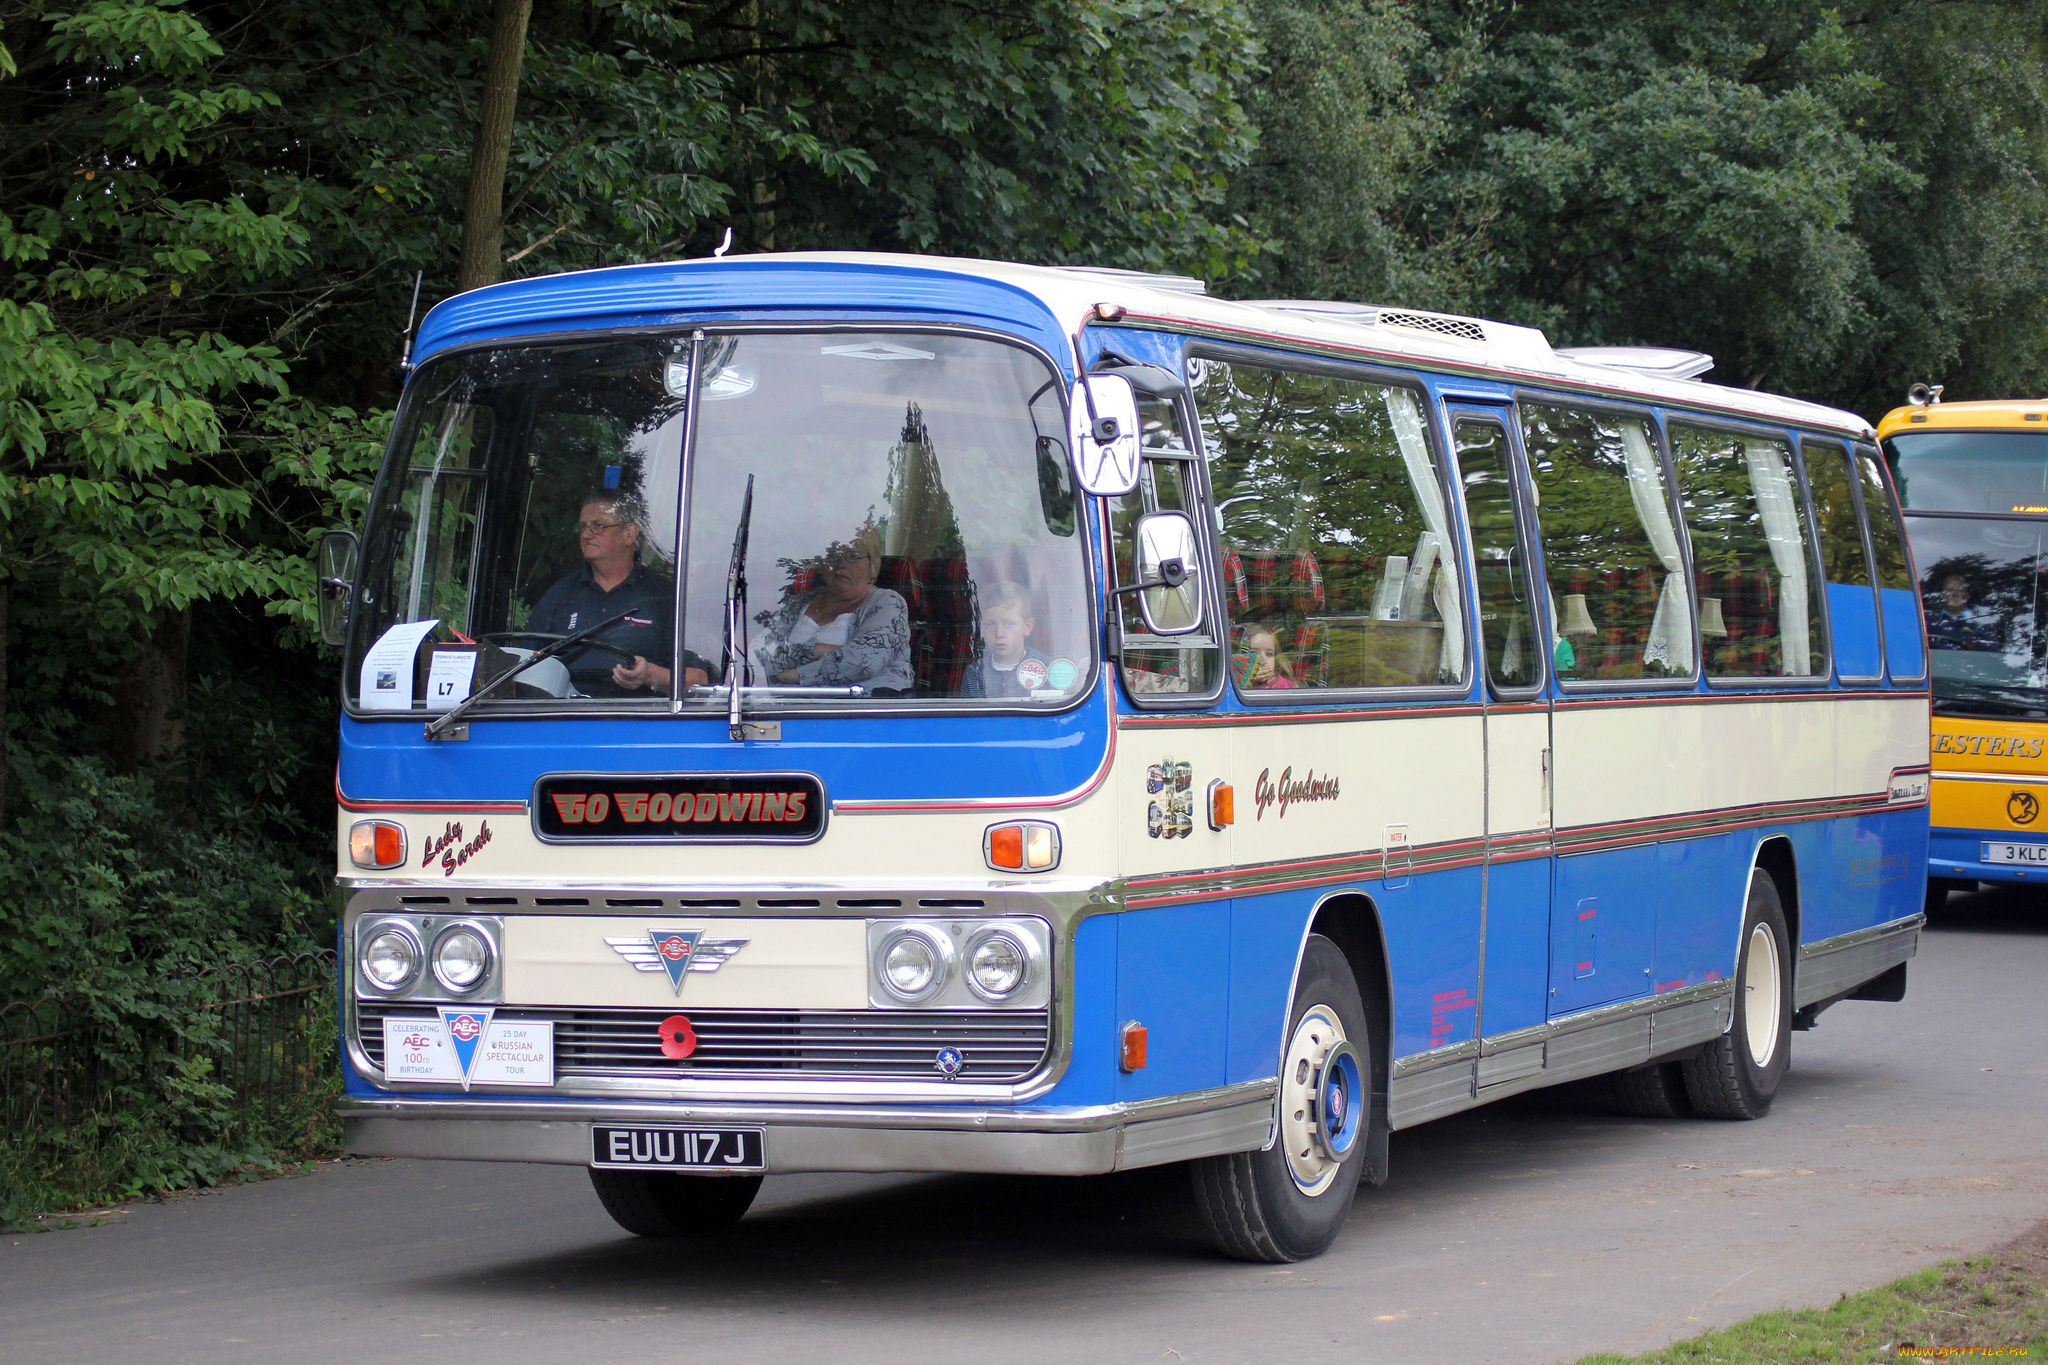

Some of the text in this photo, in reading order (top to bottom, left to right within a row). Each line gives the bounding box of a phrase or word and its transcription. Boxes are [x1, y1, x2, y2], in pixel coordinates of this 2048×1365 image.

[438, 682, 455, 696] L7
[1931, 734, 2045, 758] ESTERS
[1255, 765, 1341, 822] Go Goodwins
[551, 792, 808, 824] GO GOODWINS
[422, 821, 464, 869] Lady
[441, 819, 494, 878] Sarah
[2006, 846, 2047, 861] 3 KLC
[393, 1024, 440, 1033] CELEBRATING
[453, 1024, 480, 1033] AEC
[503, 1030, 528, 1038] 25 DAY
[403, 1036, 431, 1047] AEC
[498, 1041, 533, 1050] RUSSIAN
[404, 1053, 431, 1064] 100th
[486, 1052, 545, 1062] SPECTACULAR
[400, 1066, 434, 1074] BIRTHDAY
[505, 1066, 525, 1074] TOUR
[609, 1131, 676, 1163] EUU
